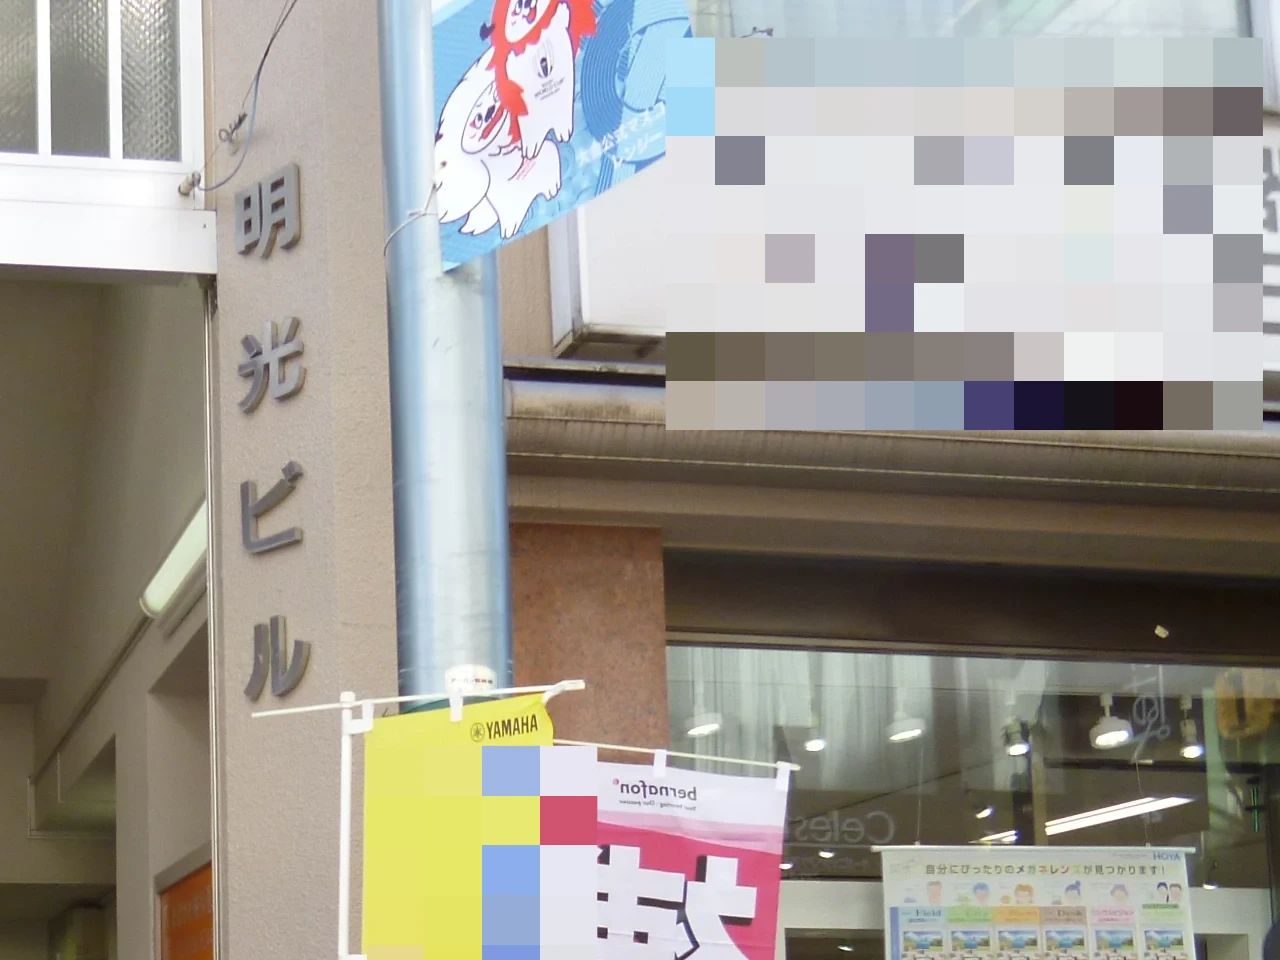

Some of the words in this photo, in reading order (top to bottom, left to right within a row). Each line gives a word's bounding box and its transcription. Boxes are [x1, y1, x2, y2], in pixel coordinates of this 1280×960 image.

[234, 162, 311, 701] 明光ビル
[486, 714, 538, 739] YAMAHA
